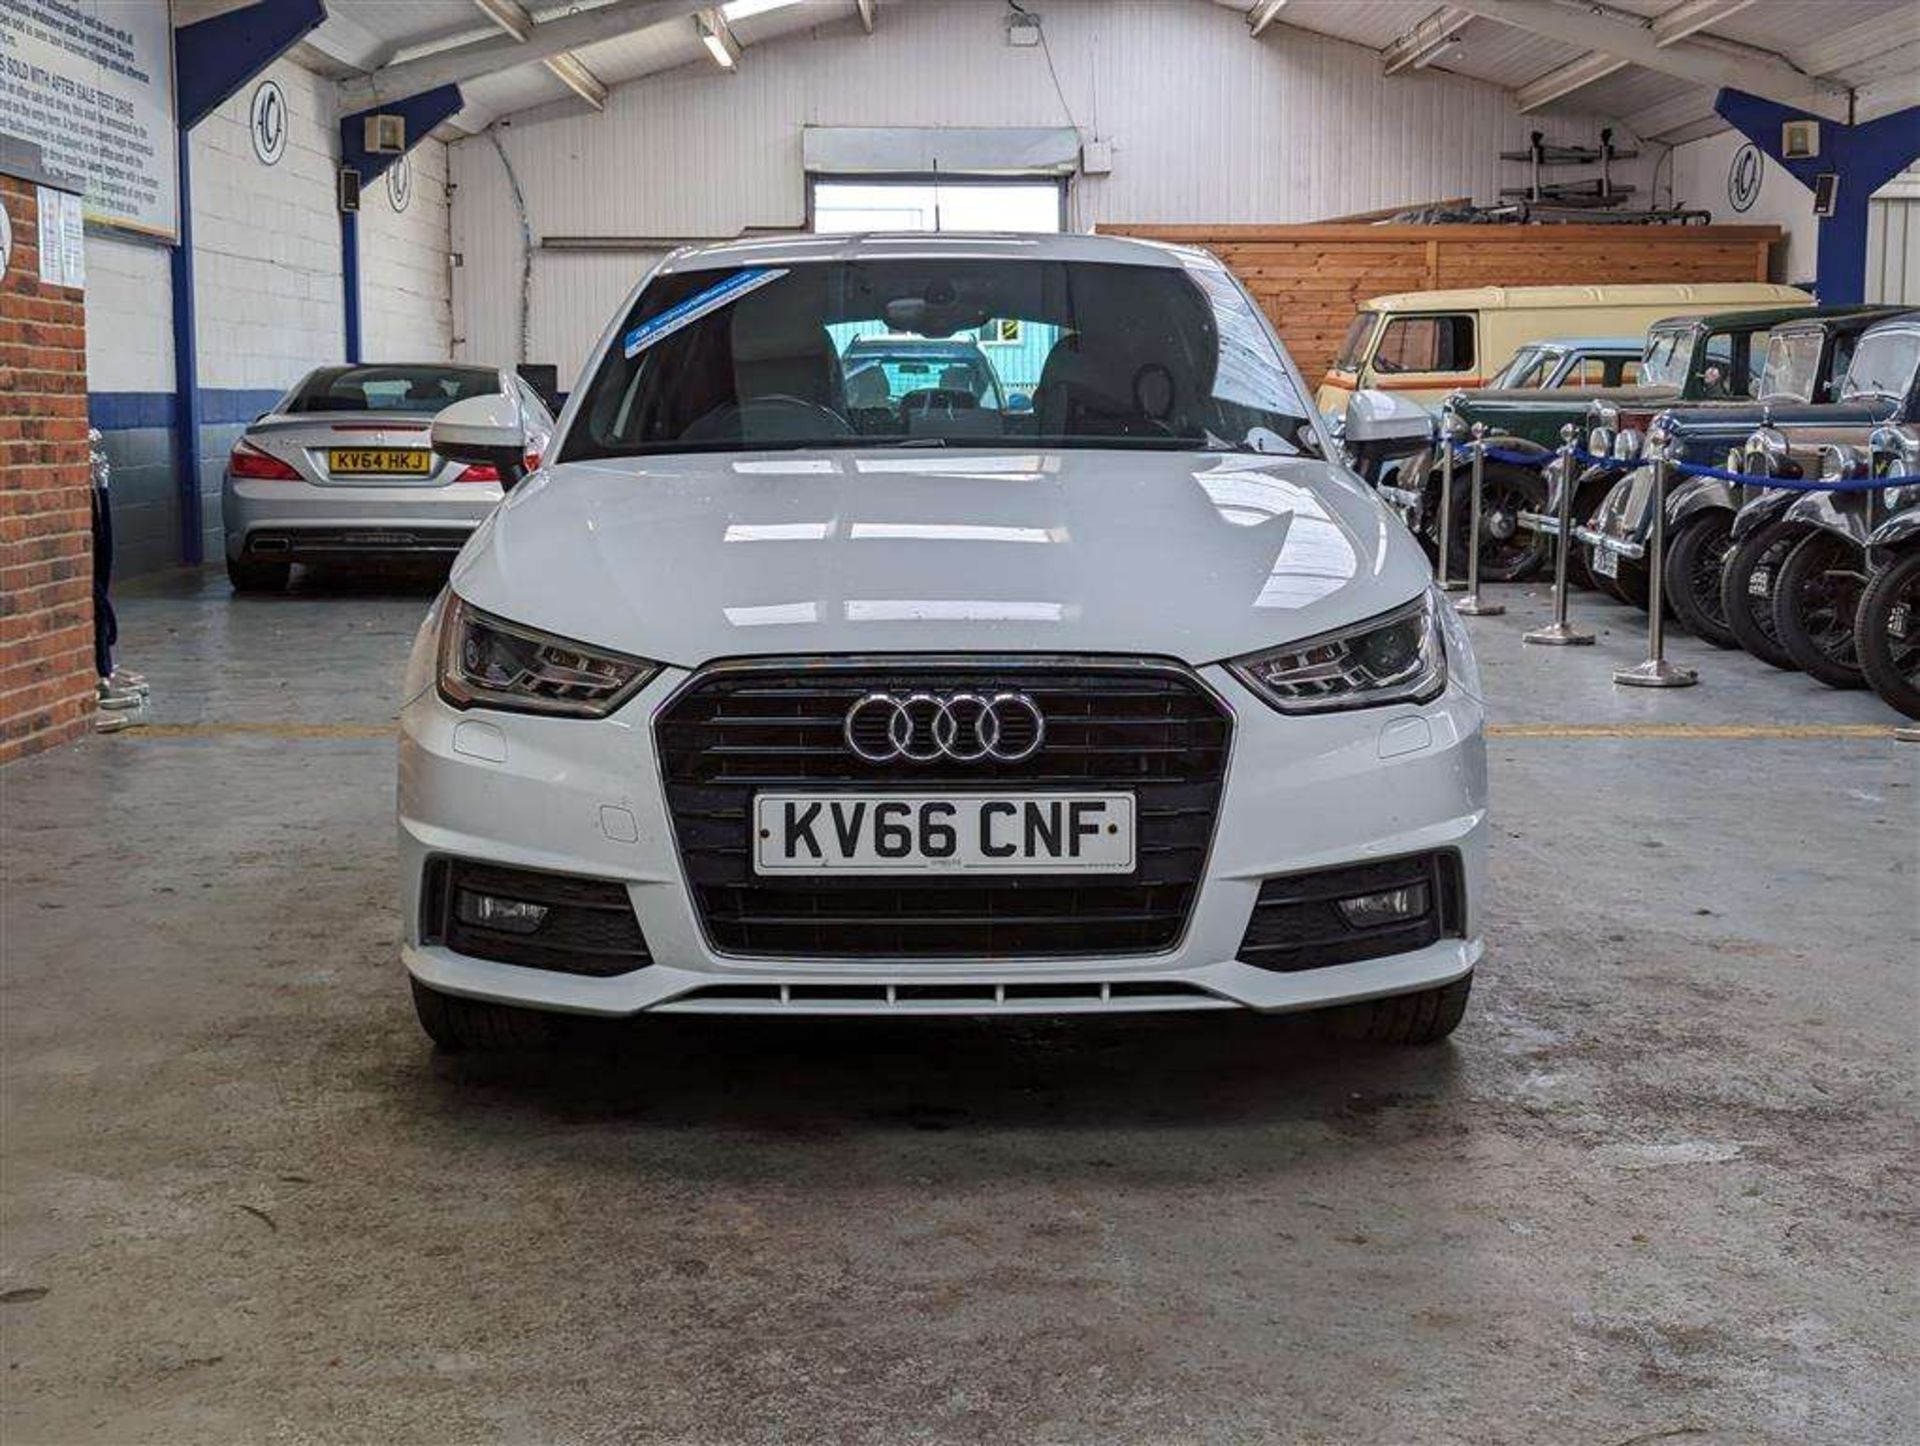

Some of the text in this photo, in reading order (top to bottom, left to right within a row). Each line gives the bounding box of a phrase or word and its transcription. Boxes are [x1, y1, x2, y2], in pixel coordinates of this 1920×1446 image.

[7, 58, 28, 80] SOLD
[31, 66, 49, 85] WITH
[52, 73, 74, 96] AFTER
[77, 82, 95, 104] SALE
[97, 91, 113, 111] TEST
[115, 98, 134, 119] DRIVE
[337, 452, 423, 469] KV64 HKJ
[784, 801, 1106, 858] KV66 CNF
